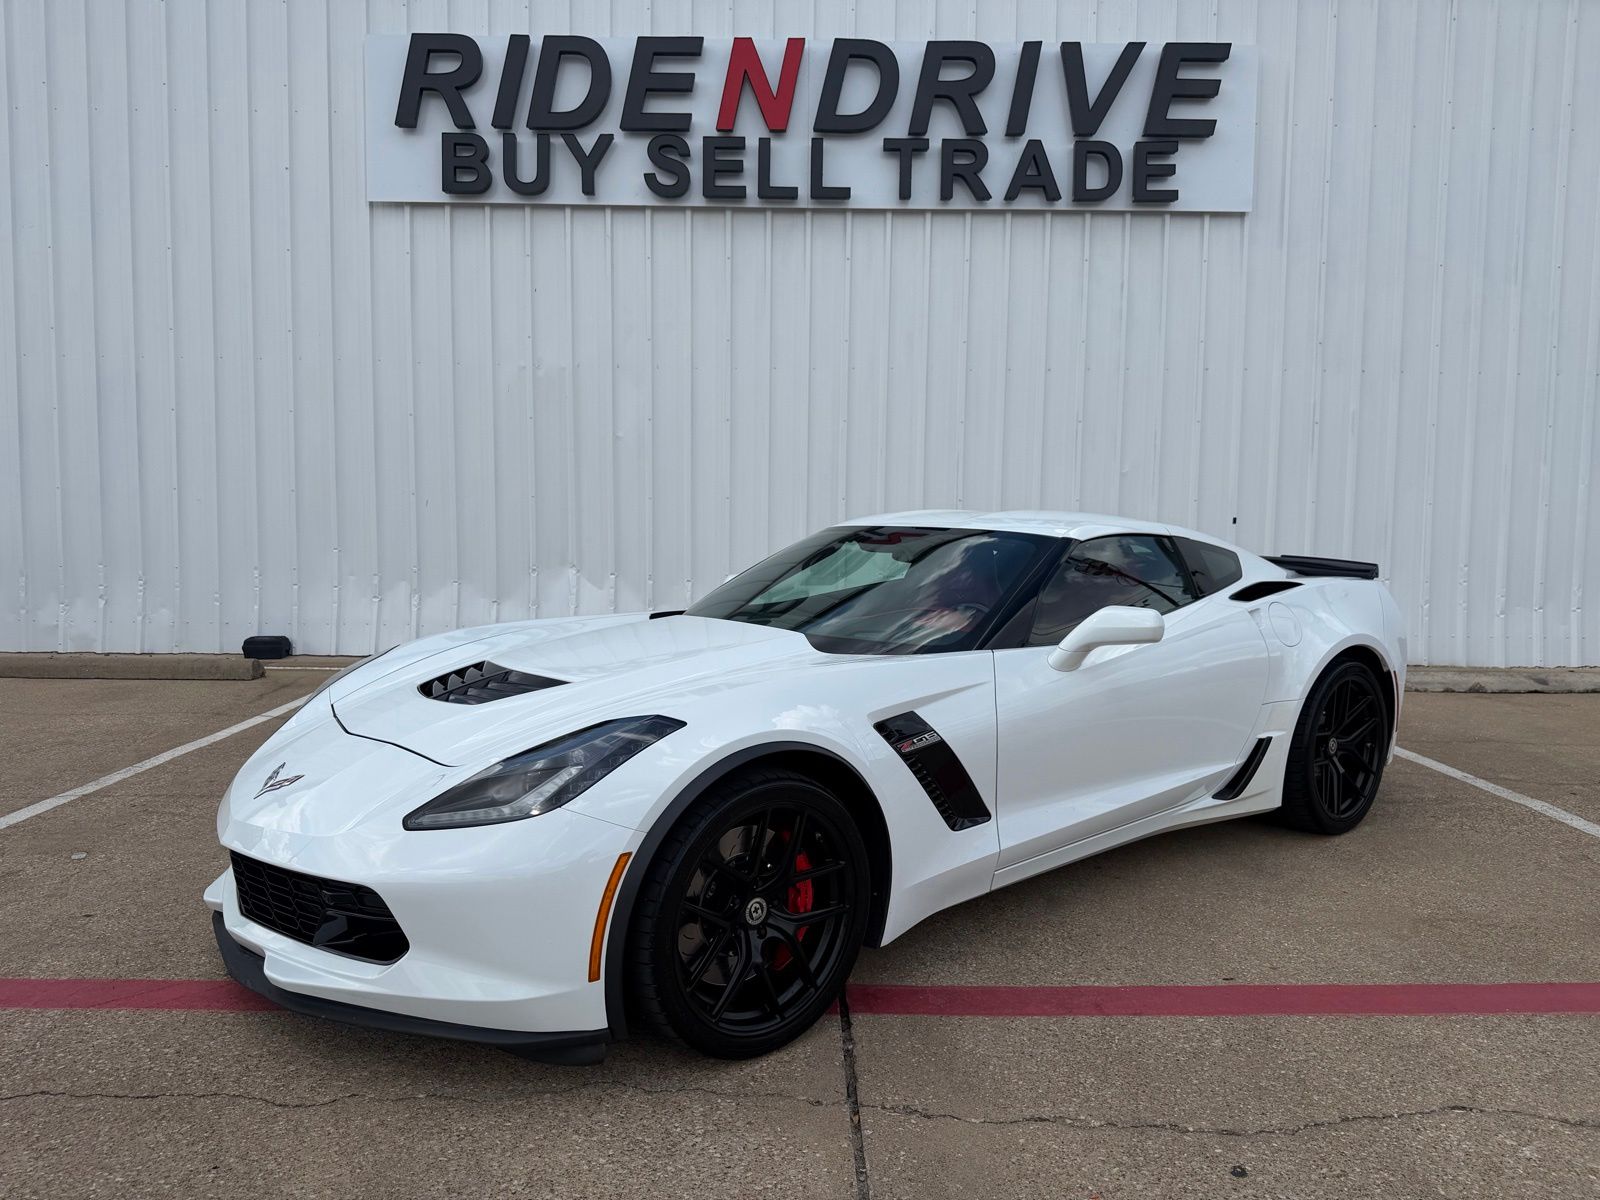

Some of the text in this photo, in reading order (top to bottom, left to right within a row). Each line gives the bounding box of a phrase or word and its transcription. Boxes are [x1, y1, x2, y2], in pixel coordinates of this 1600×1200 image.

[441, 132, 1179, 203] BUY SELL TRADE
